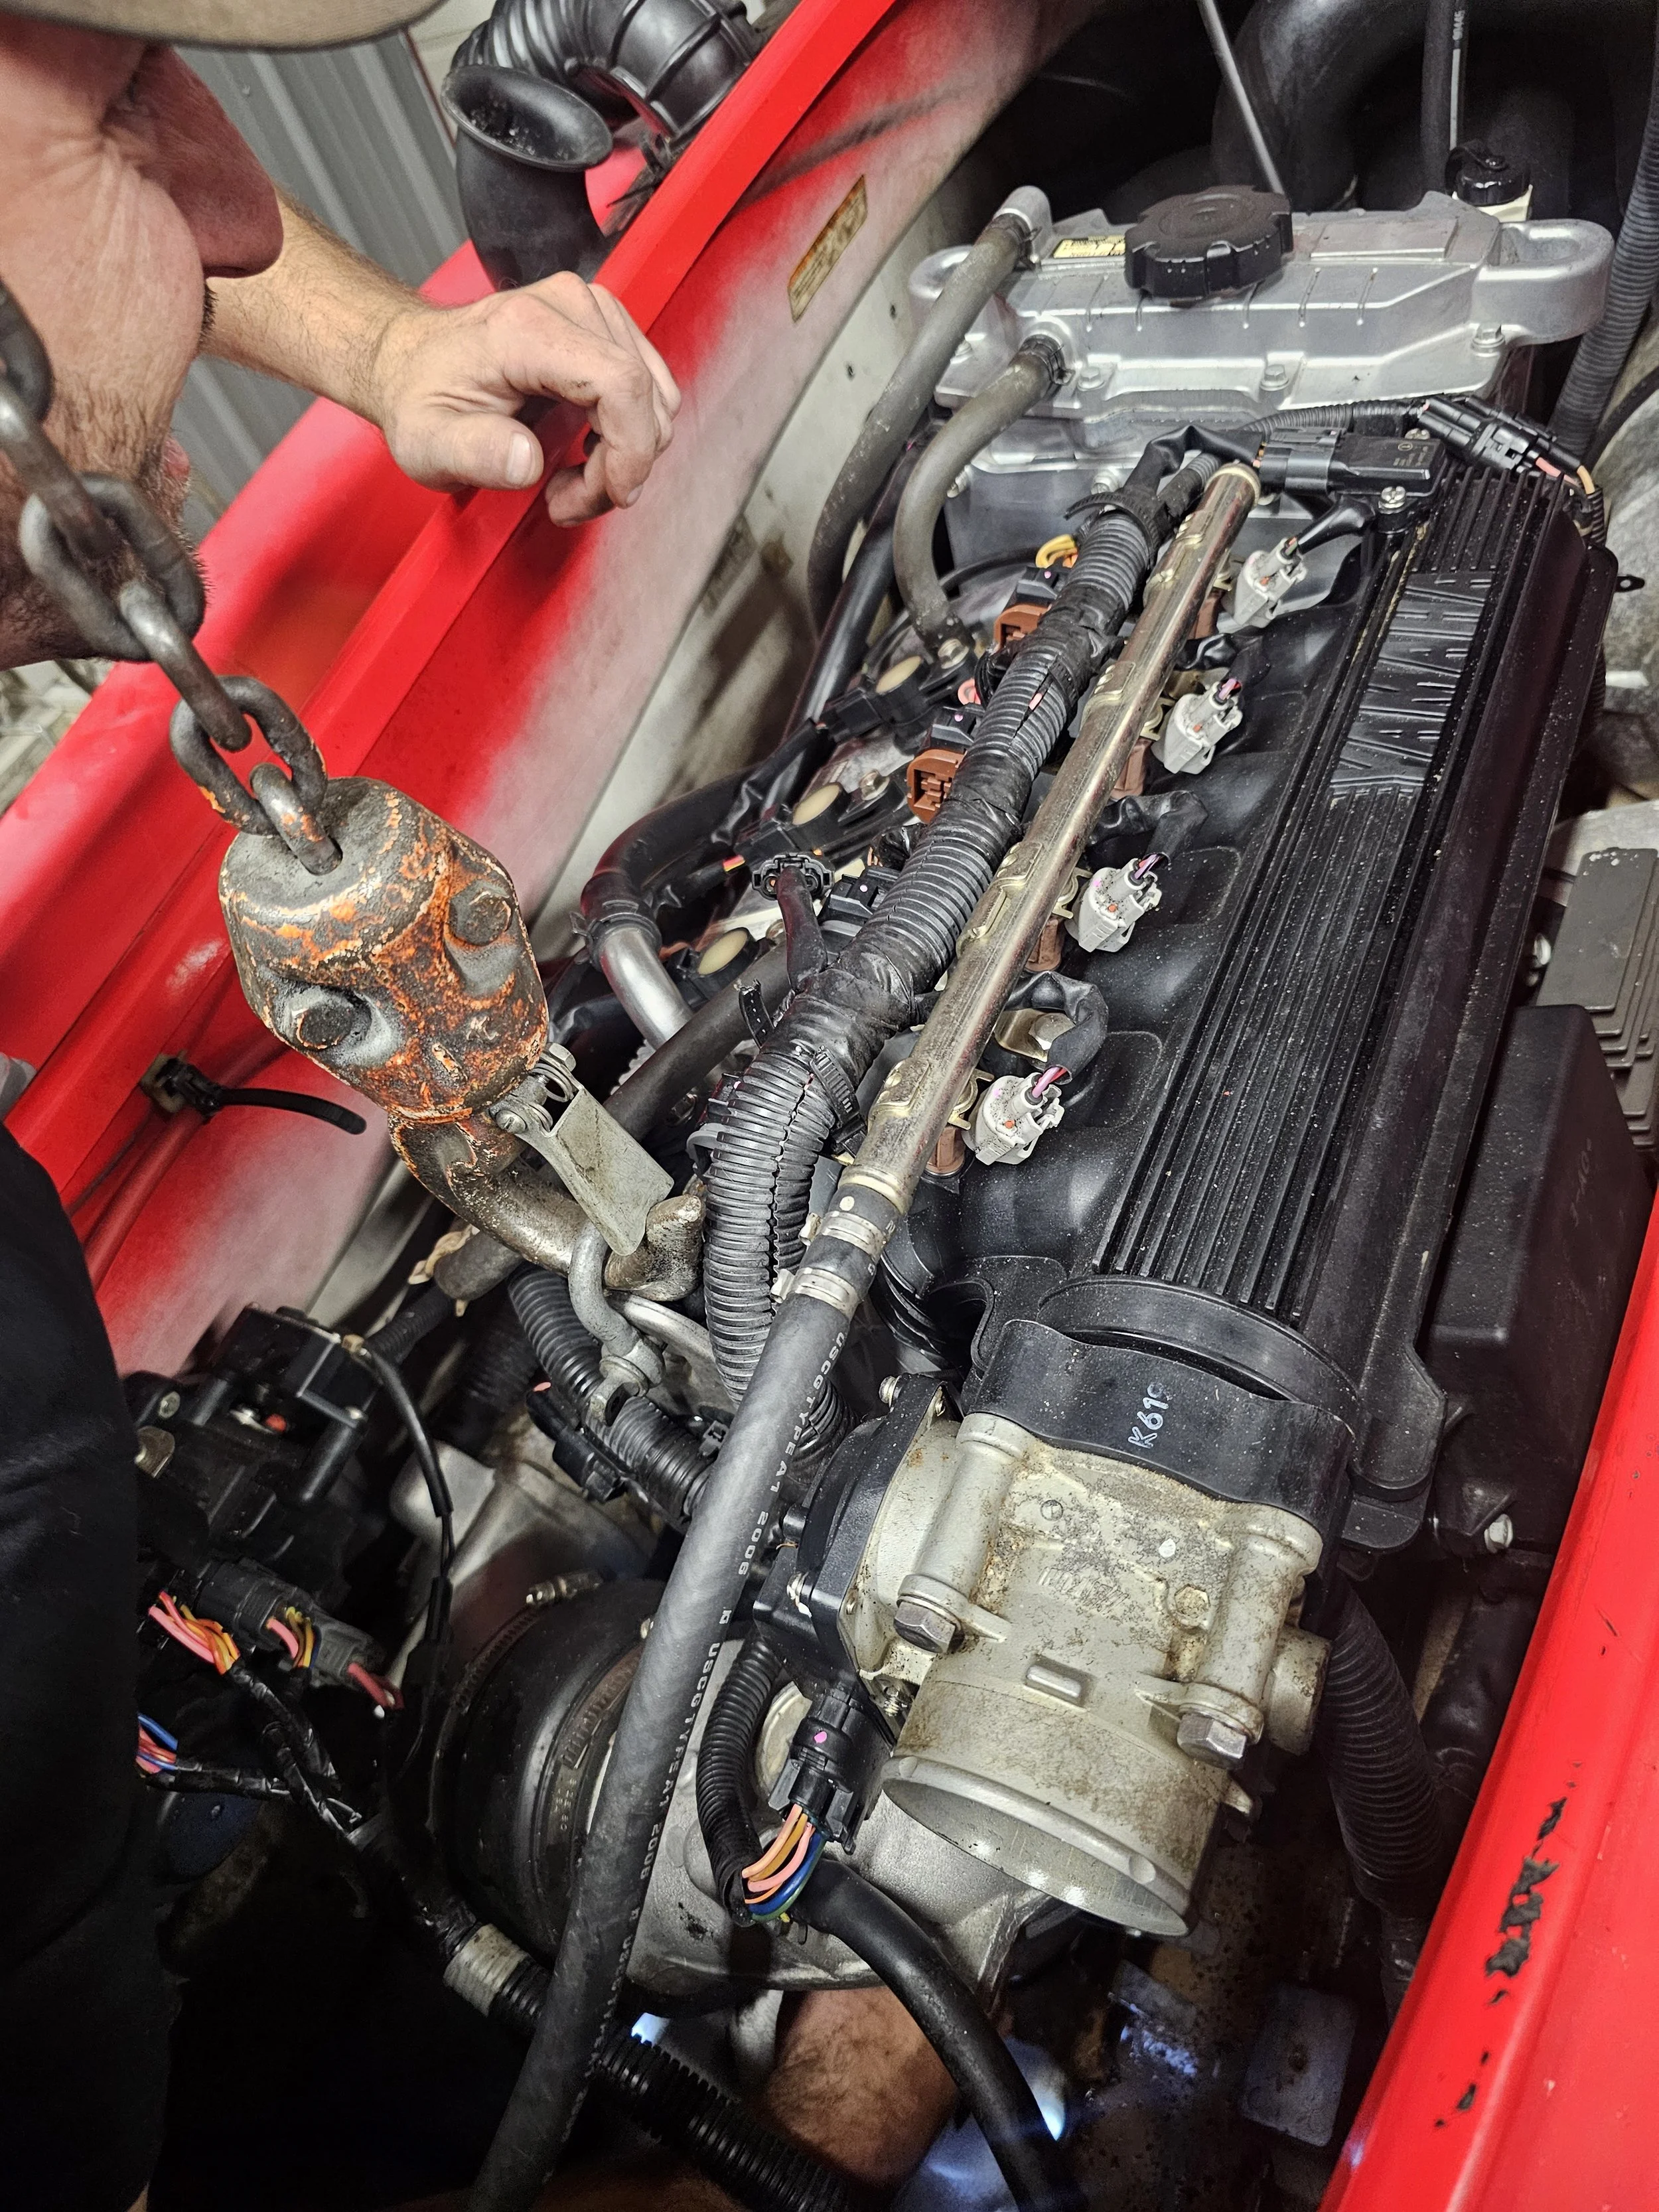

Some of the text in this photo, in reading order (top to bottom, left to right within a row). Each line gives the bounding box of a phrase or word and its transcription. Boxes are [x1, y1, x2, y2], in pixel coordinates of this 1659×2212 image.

[1328, 572, 1493, 788] YAMAHA
[738, 1332, 845, 1575] USCG TYPE A1 2006
[690, 1643, 721, 1708] USCG
